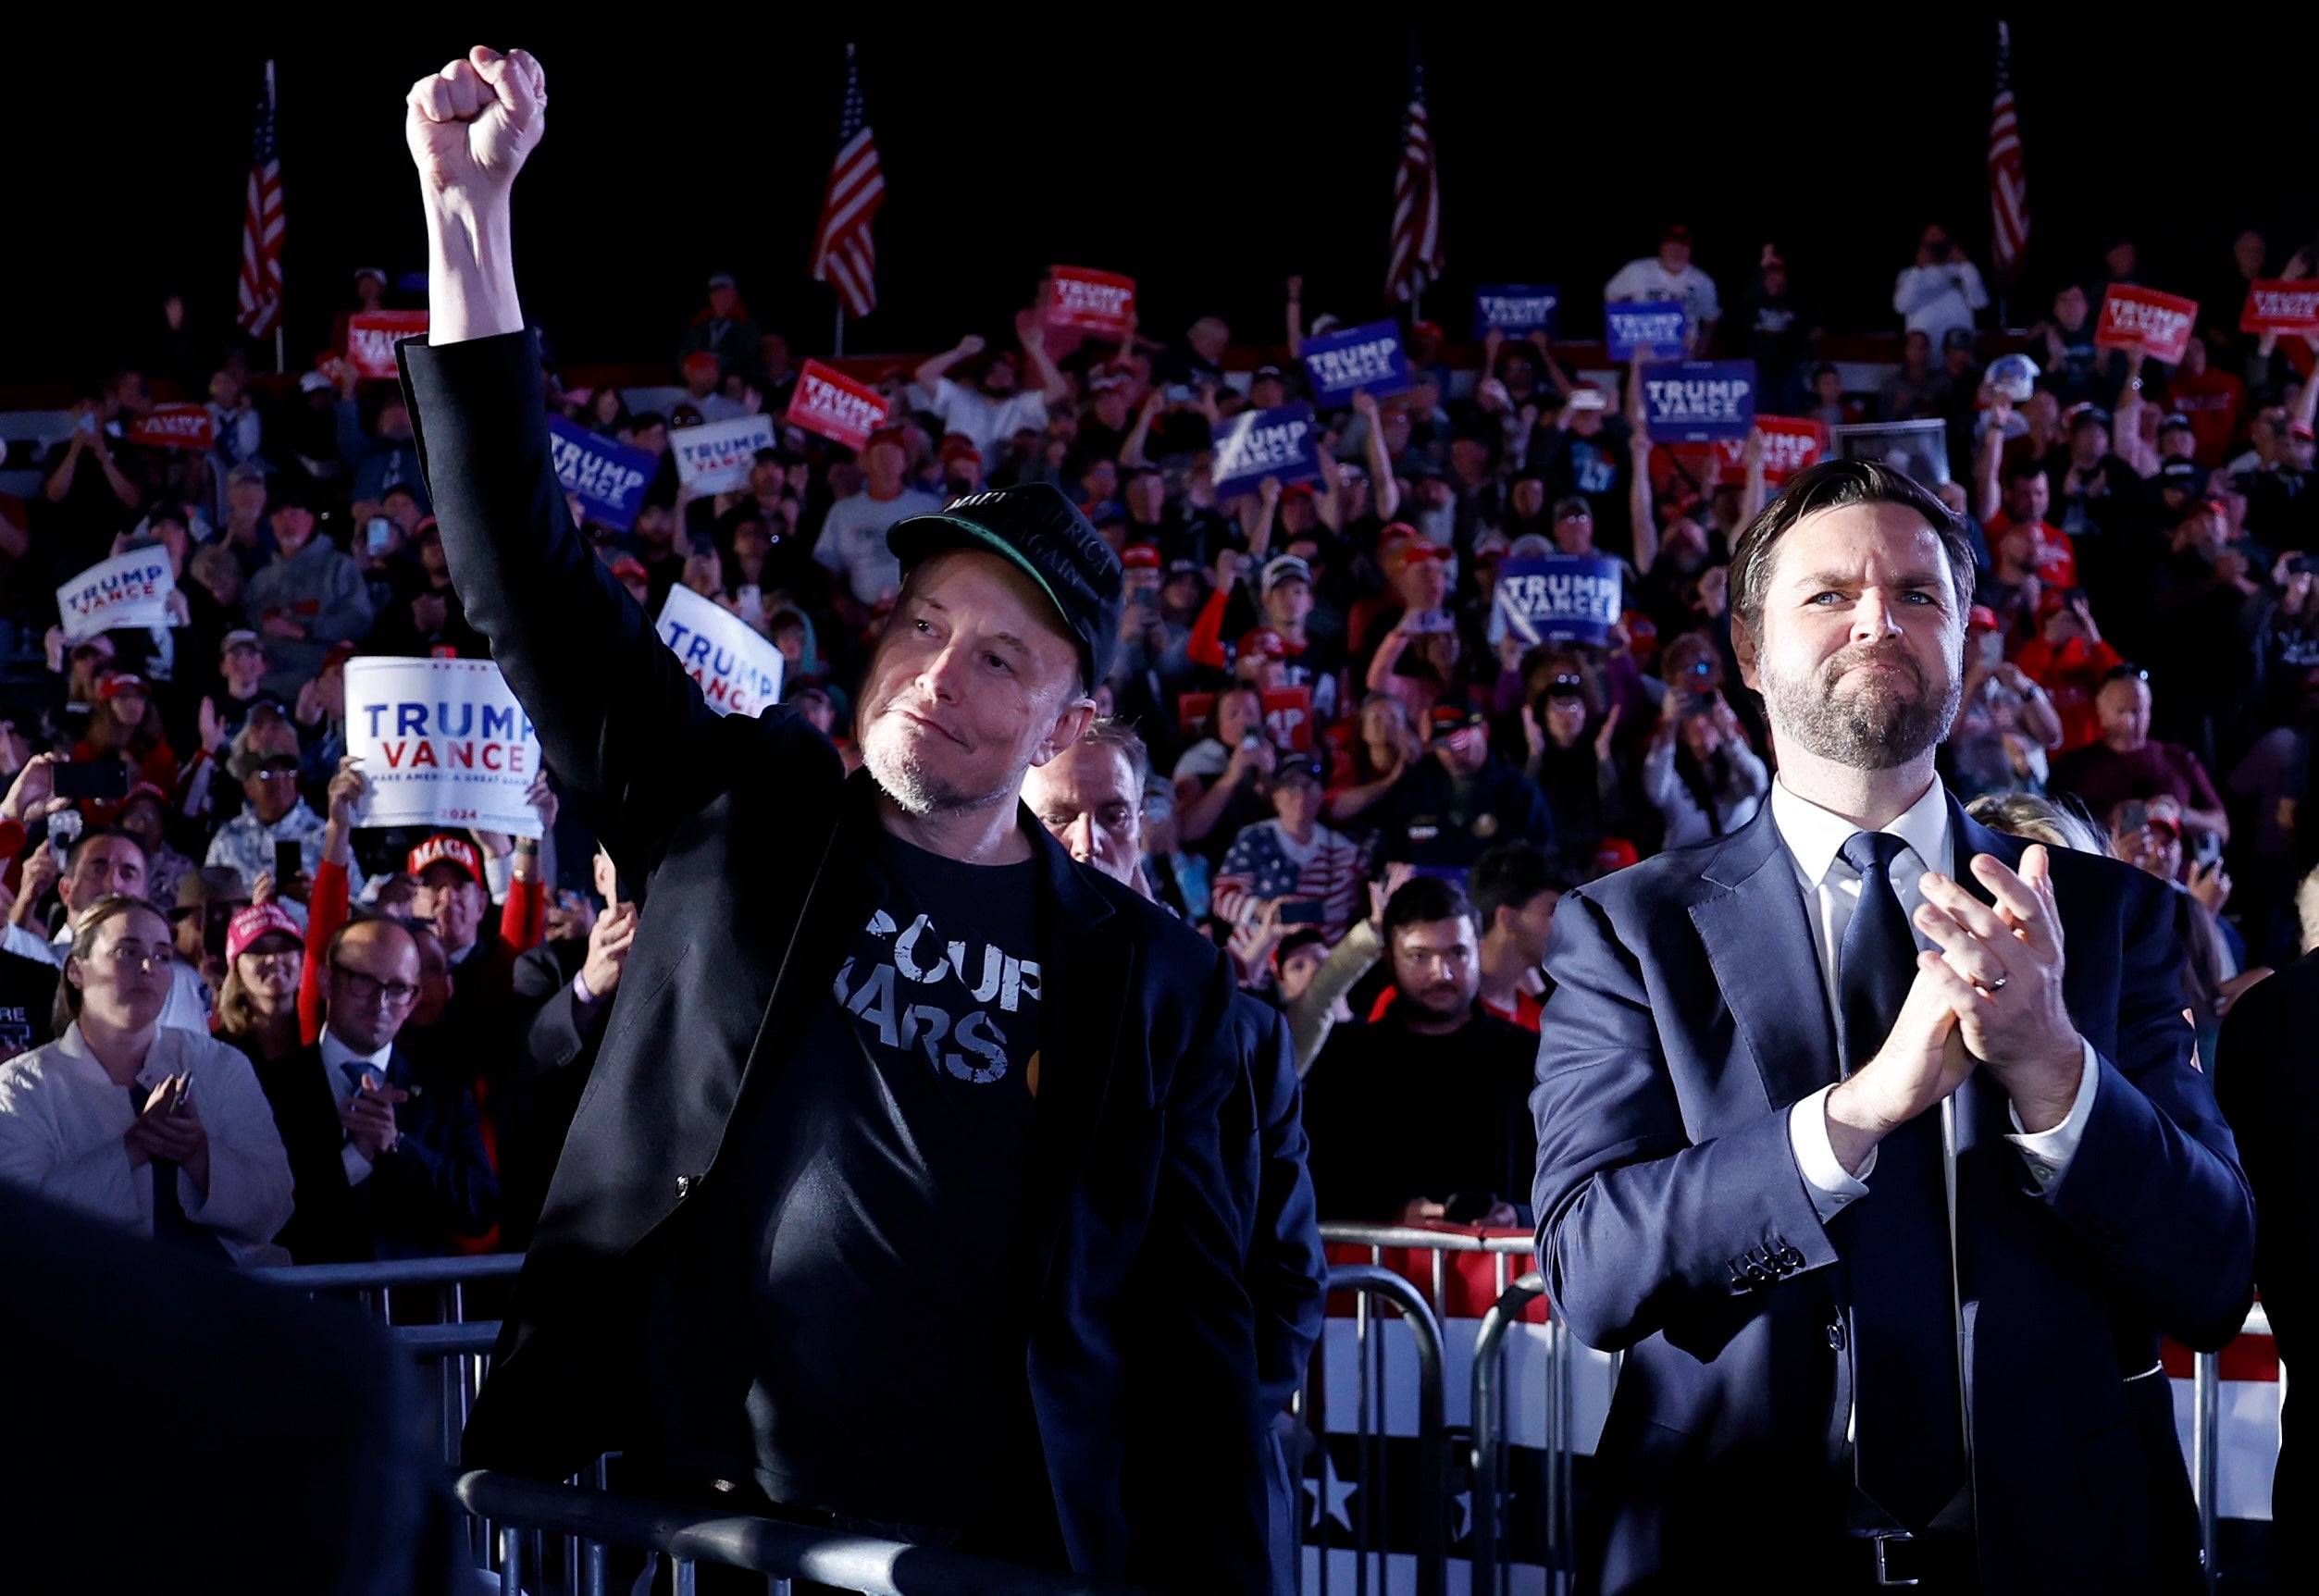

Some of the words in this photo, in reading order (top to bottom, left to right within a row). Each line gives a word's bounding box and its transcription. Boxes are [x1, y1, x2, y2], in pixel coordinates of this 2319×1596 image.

[1307, 338, 1397, 373] TRUMP
[1645, 380, 1750, 401] TRUMP
[1655, 399, 1740, 417] VANCE
[683, 433, 769, 462] TRUMP
[68, 564, 163, 611] TRUMP
[1504, 575, 1616, 600] TRUMP
[1516, 594, 1606, 614] VANCE
[668, 621, 773, 697] TRUMP
[382, 739, 526, 773] VANCE
[441, 809, 477, 820] 2024
[413, 837, 475, 869] MAGA
